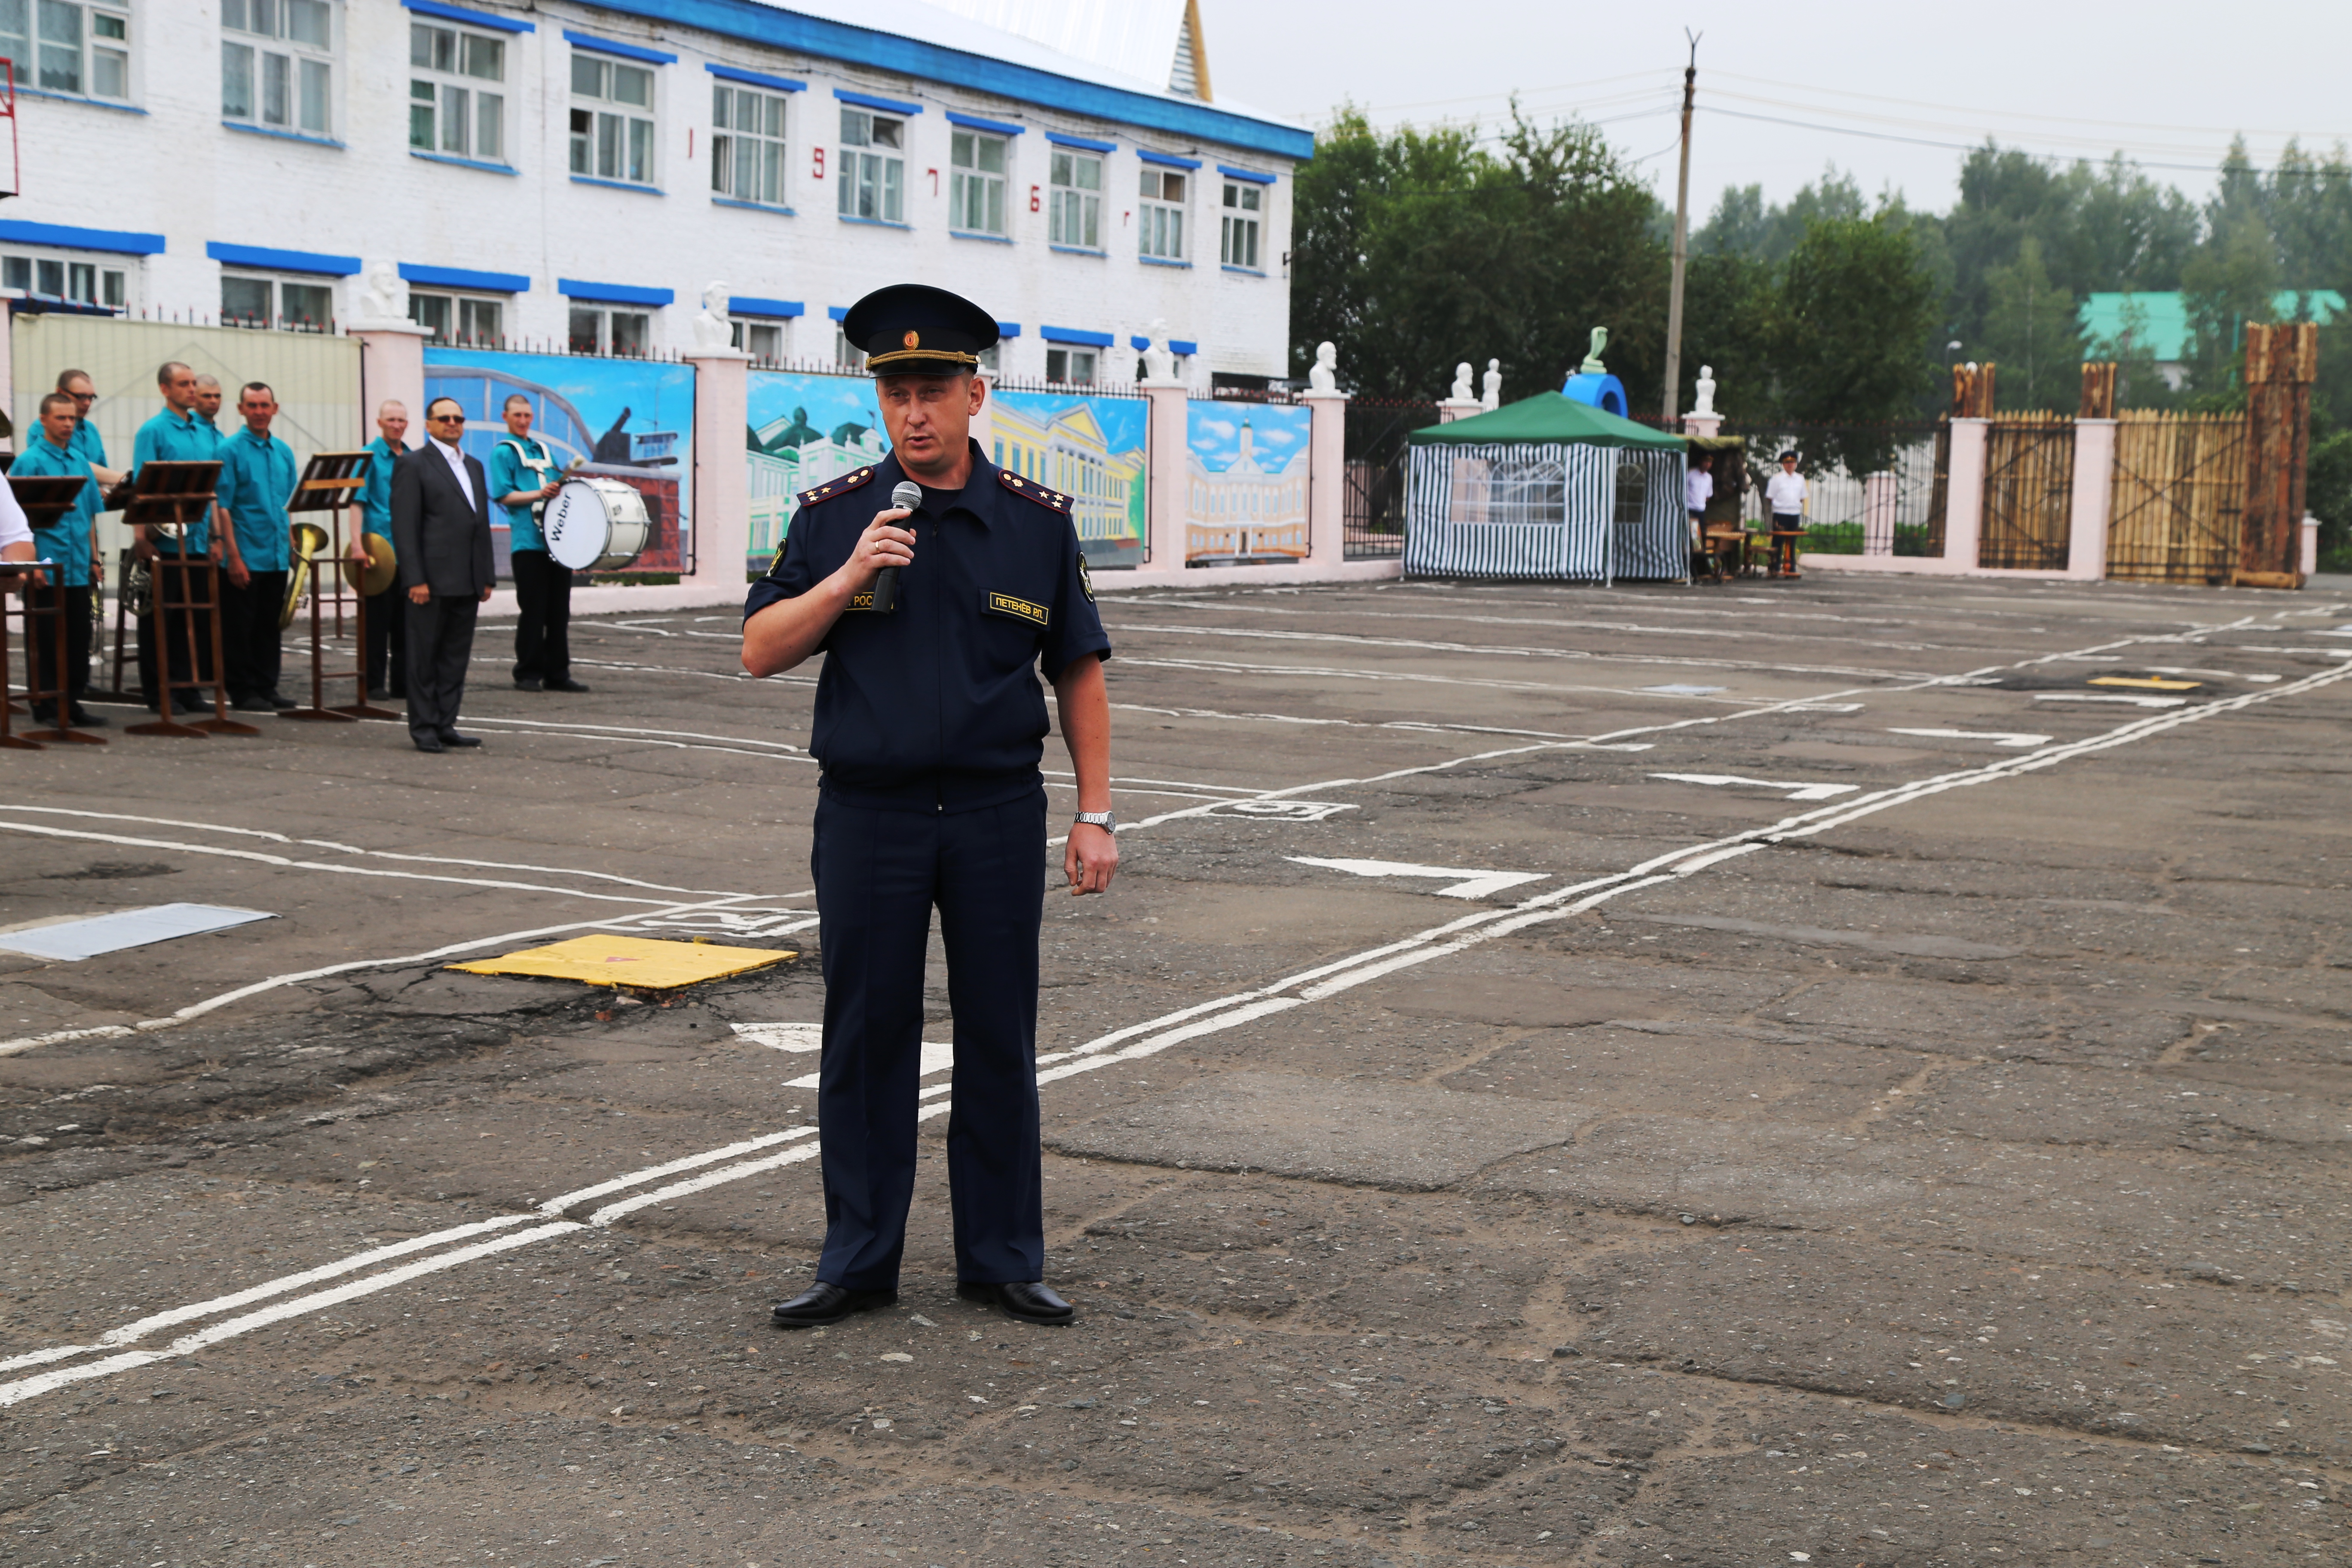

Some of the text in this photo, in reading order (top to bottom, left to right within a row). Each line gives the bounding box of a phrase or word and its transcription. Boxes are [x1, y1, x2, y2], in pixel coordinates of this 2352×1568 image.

[813, 147, 824, 179] 9
[927, 168, 938, 196] 7
[1031, 185, 1040, 212] 6
[551, 491, 573, 542] Weber
[854, 595, 873, 606] РОС
[995, 597, 1031, 614] ПЕТЕНЁВ
